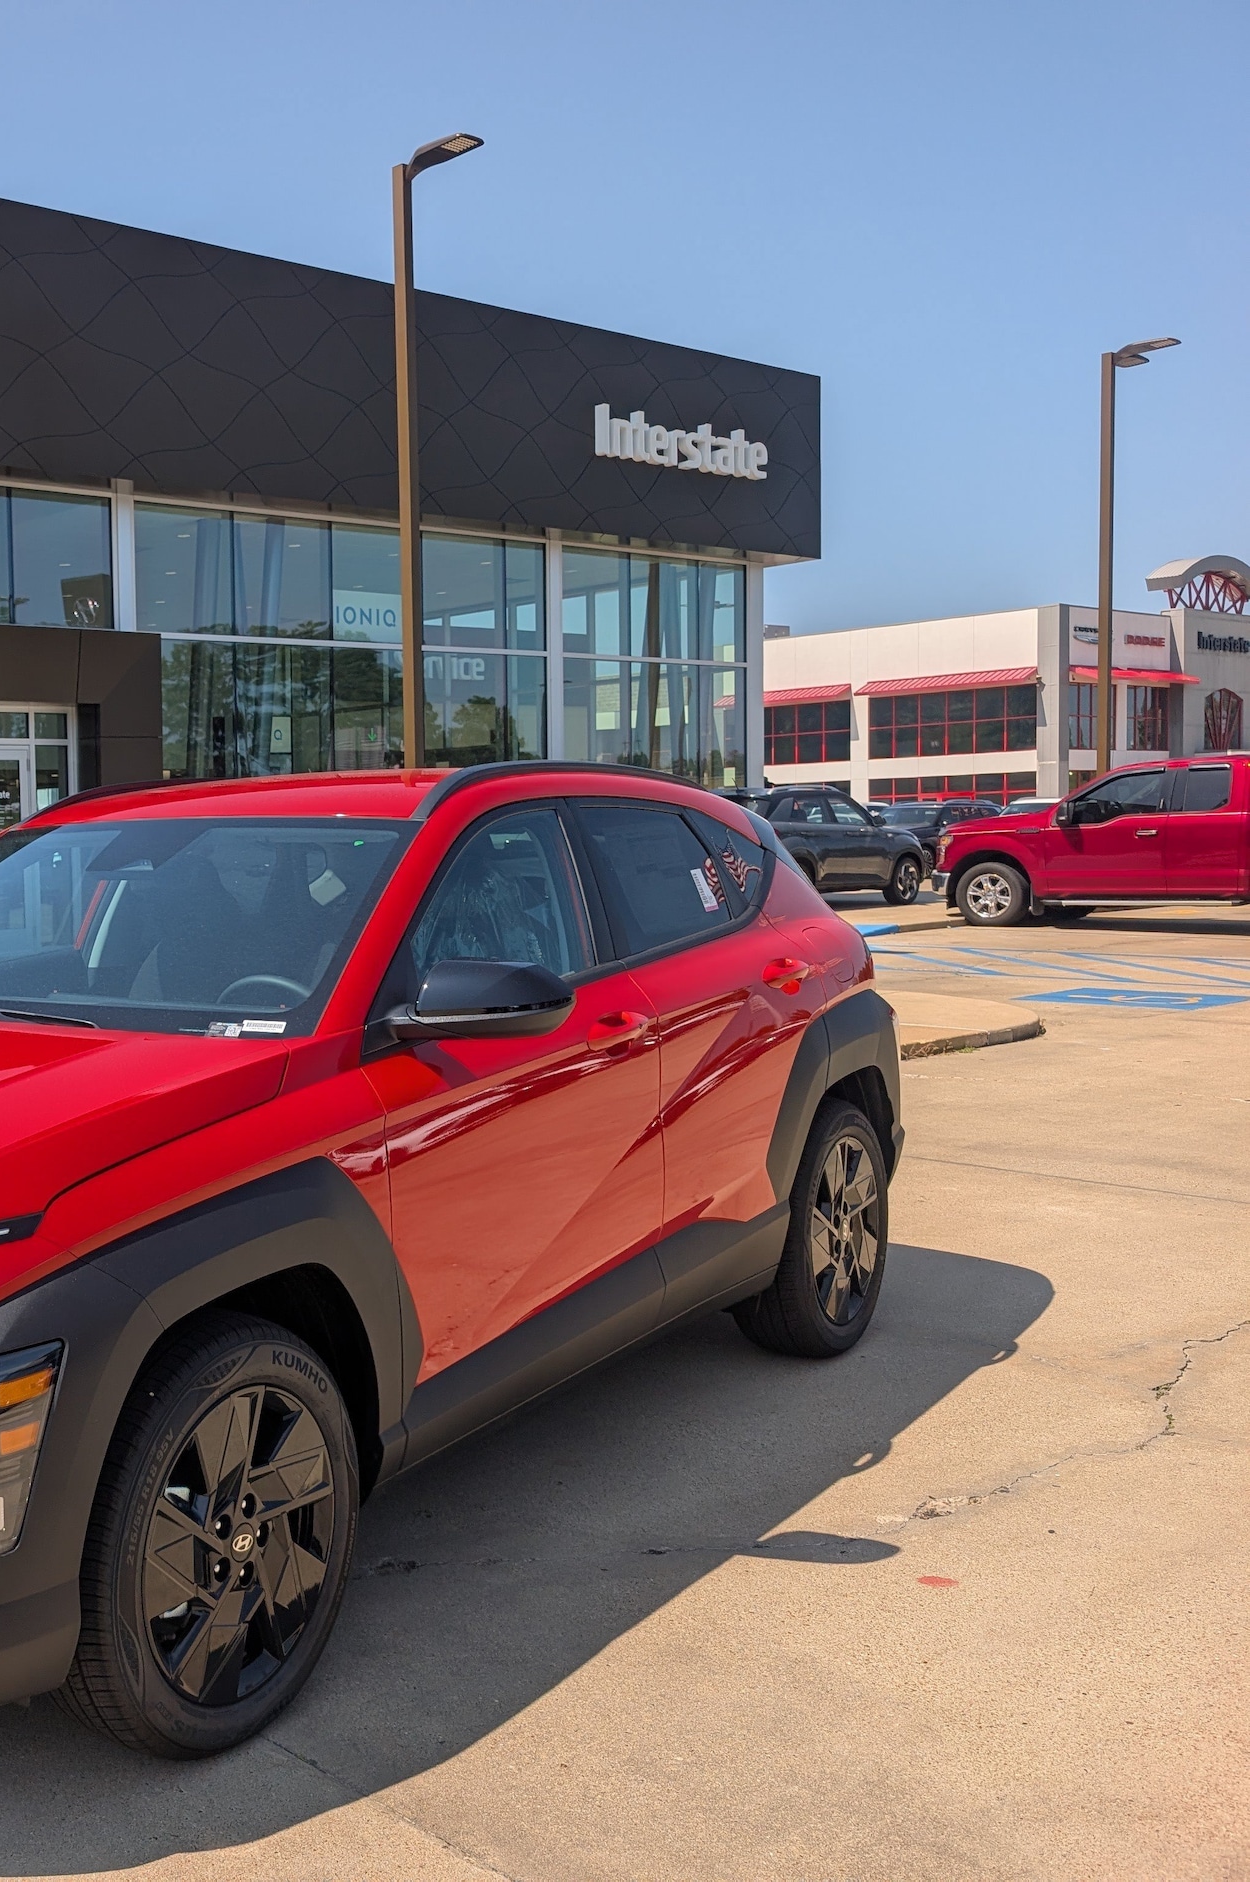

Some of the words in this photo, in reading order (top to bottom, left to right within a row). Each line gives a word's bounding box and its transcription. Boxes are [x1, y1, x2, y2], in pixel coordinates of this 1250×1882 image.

[595, 403, 768, 480] Interstate
[336, 606, 397, 628] IONIQ
[1124, 634, 1165, 647] DODGE
[1197, 631, 1250, 653] Interstate
[272, 1350, 328, 1394] KUMHO
[141, 1464, 158, 1500] R18
